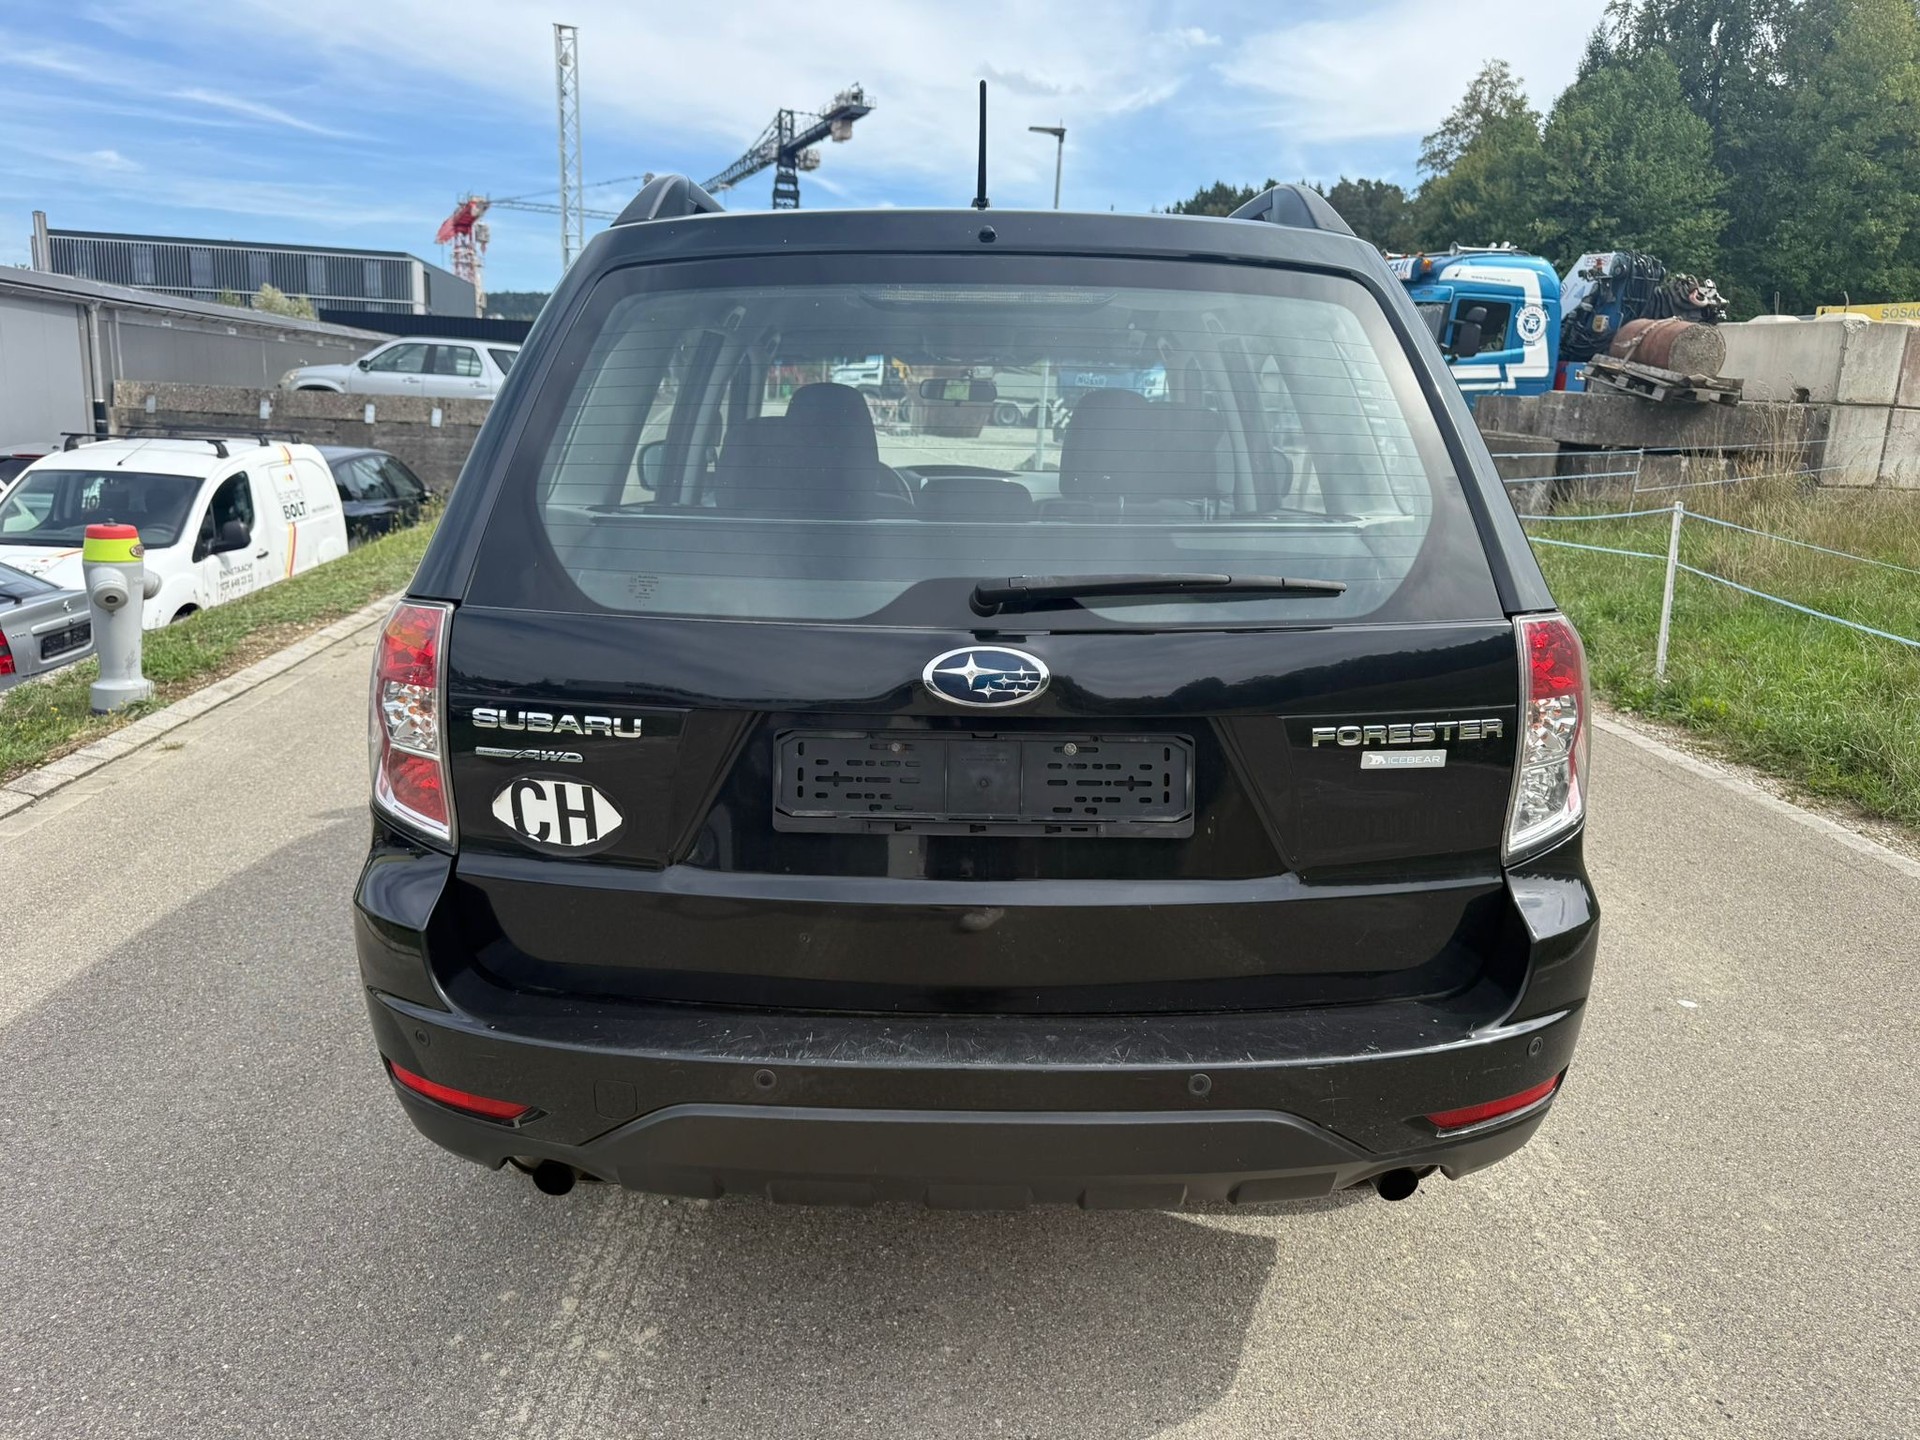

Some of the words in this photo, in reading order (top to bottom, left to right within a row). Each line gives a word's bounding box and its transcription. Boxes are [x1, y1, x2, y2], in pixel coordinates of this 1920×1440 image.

[283, 501, 306, 519] BOLT
[471, 707, 642, 739] SUBARU
[1311, 718, 1503, 748] FORESTER
[515, 749, 584, 763] AWD
[1387, 755, 1441, 764] ICEBEAR
[511, 780, 598, 845] CH
